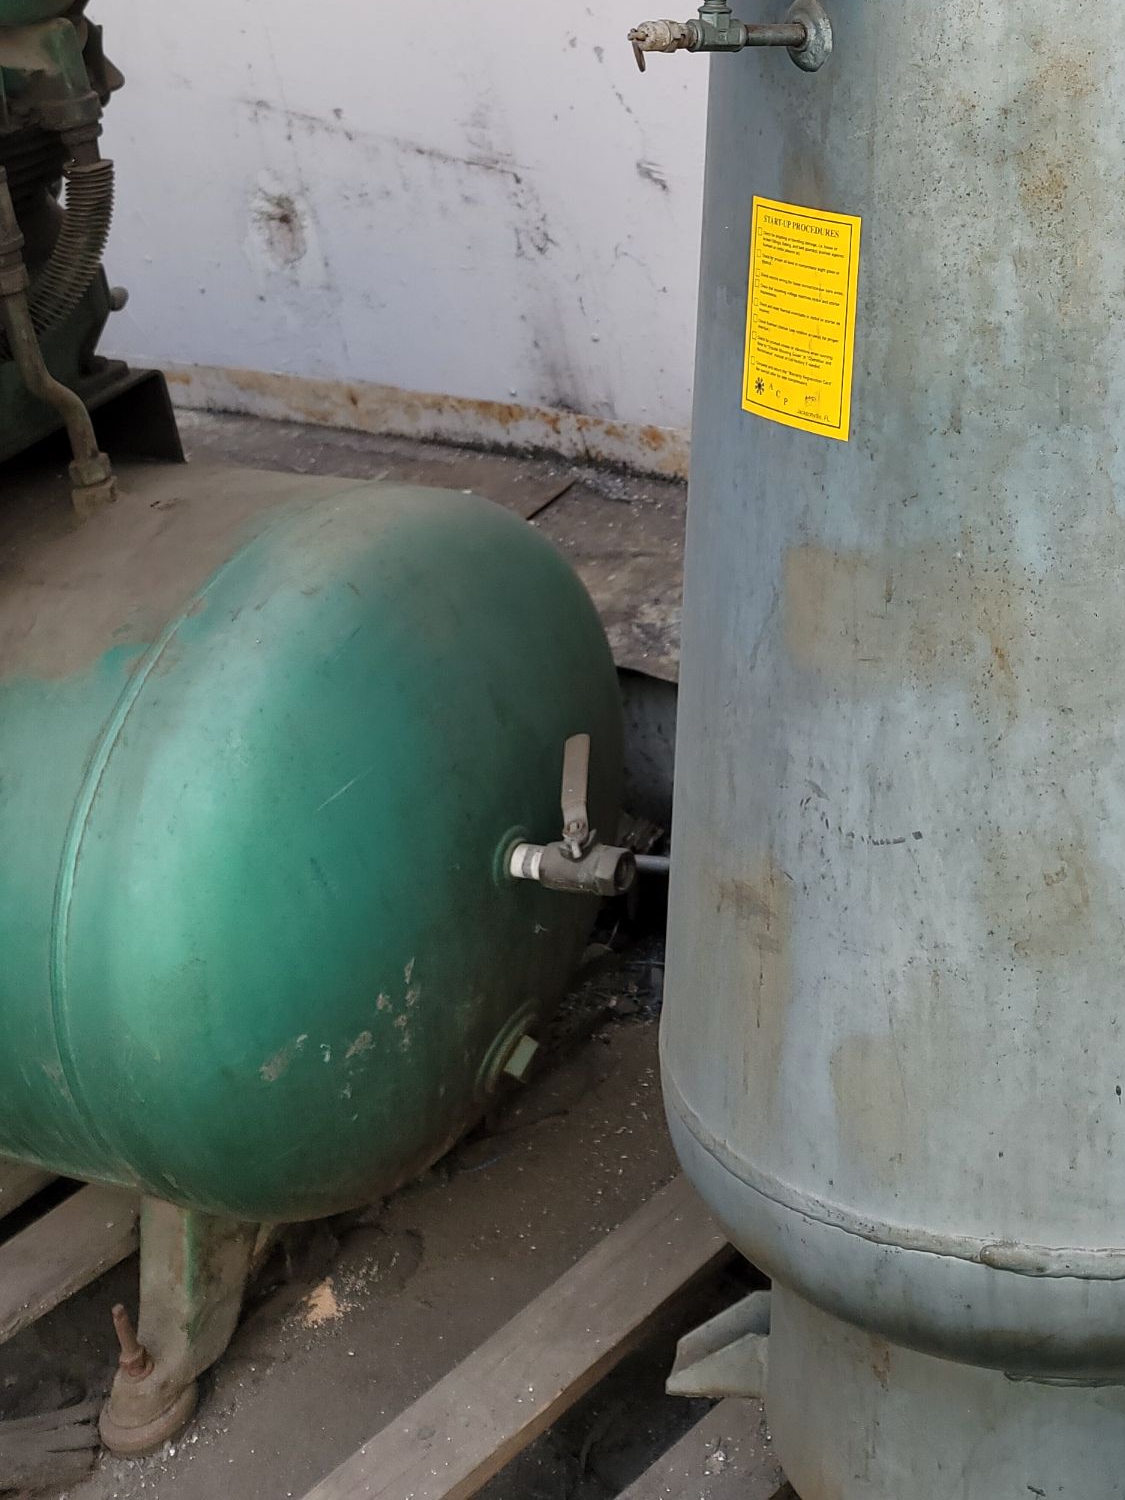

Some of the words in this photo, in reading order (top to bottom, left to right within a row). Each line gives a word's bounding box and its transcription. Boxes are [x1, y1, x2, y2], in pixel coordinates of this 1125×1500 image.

[763, 214, 791, 228] START-UP
[792, 221, 839, 239] PROCEDURES
[775, 389, 780, 397] C
[783, 396, 788, 406] P
